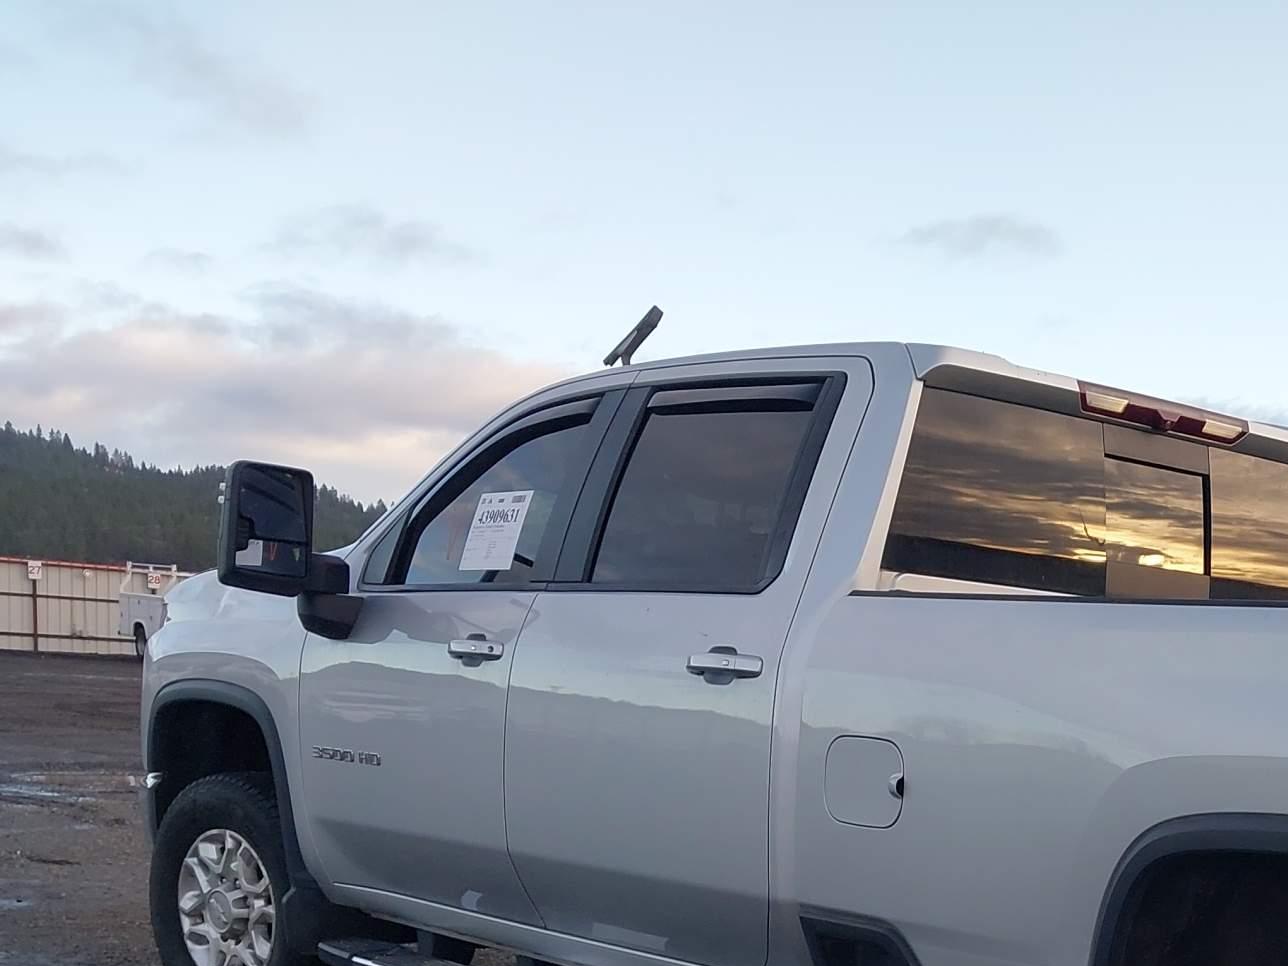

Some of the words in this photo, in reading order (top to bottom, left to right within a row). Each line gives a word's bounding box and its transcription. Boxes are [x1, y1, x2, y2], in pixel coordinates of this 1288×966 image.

[478, 508, 520, 524] 43909631
[29, 566, 41, 575] 27
[148, 575, 161, 585] 28
[312, 745, 355, 763] 3500
[358, 751, 381, 767] HD
